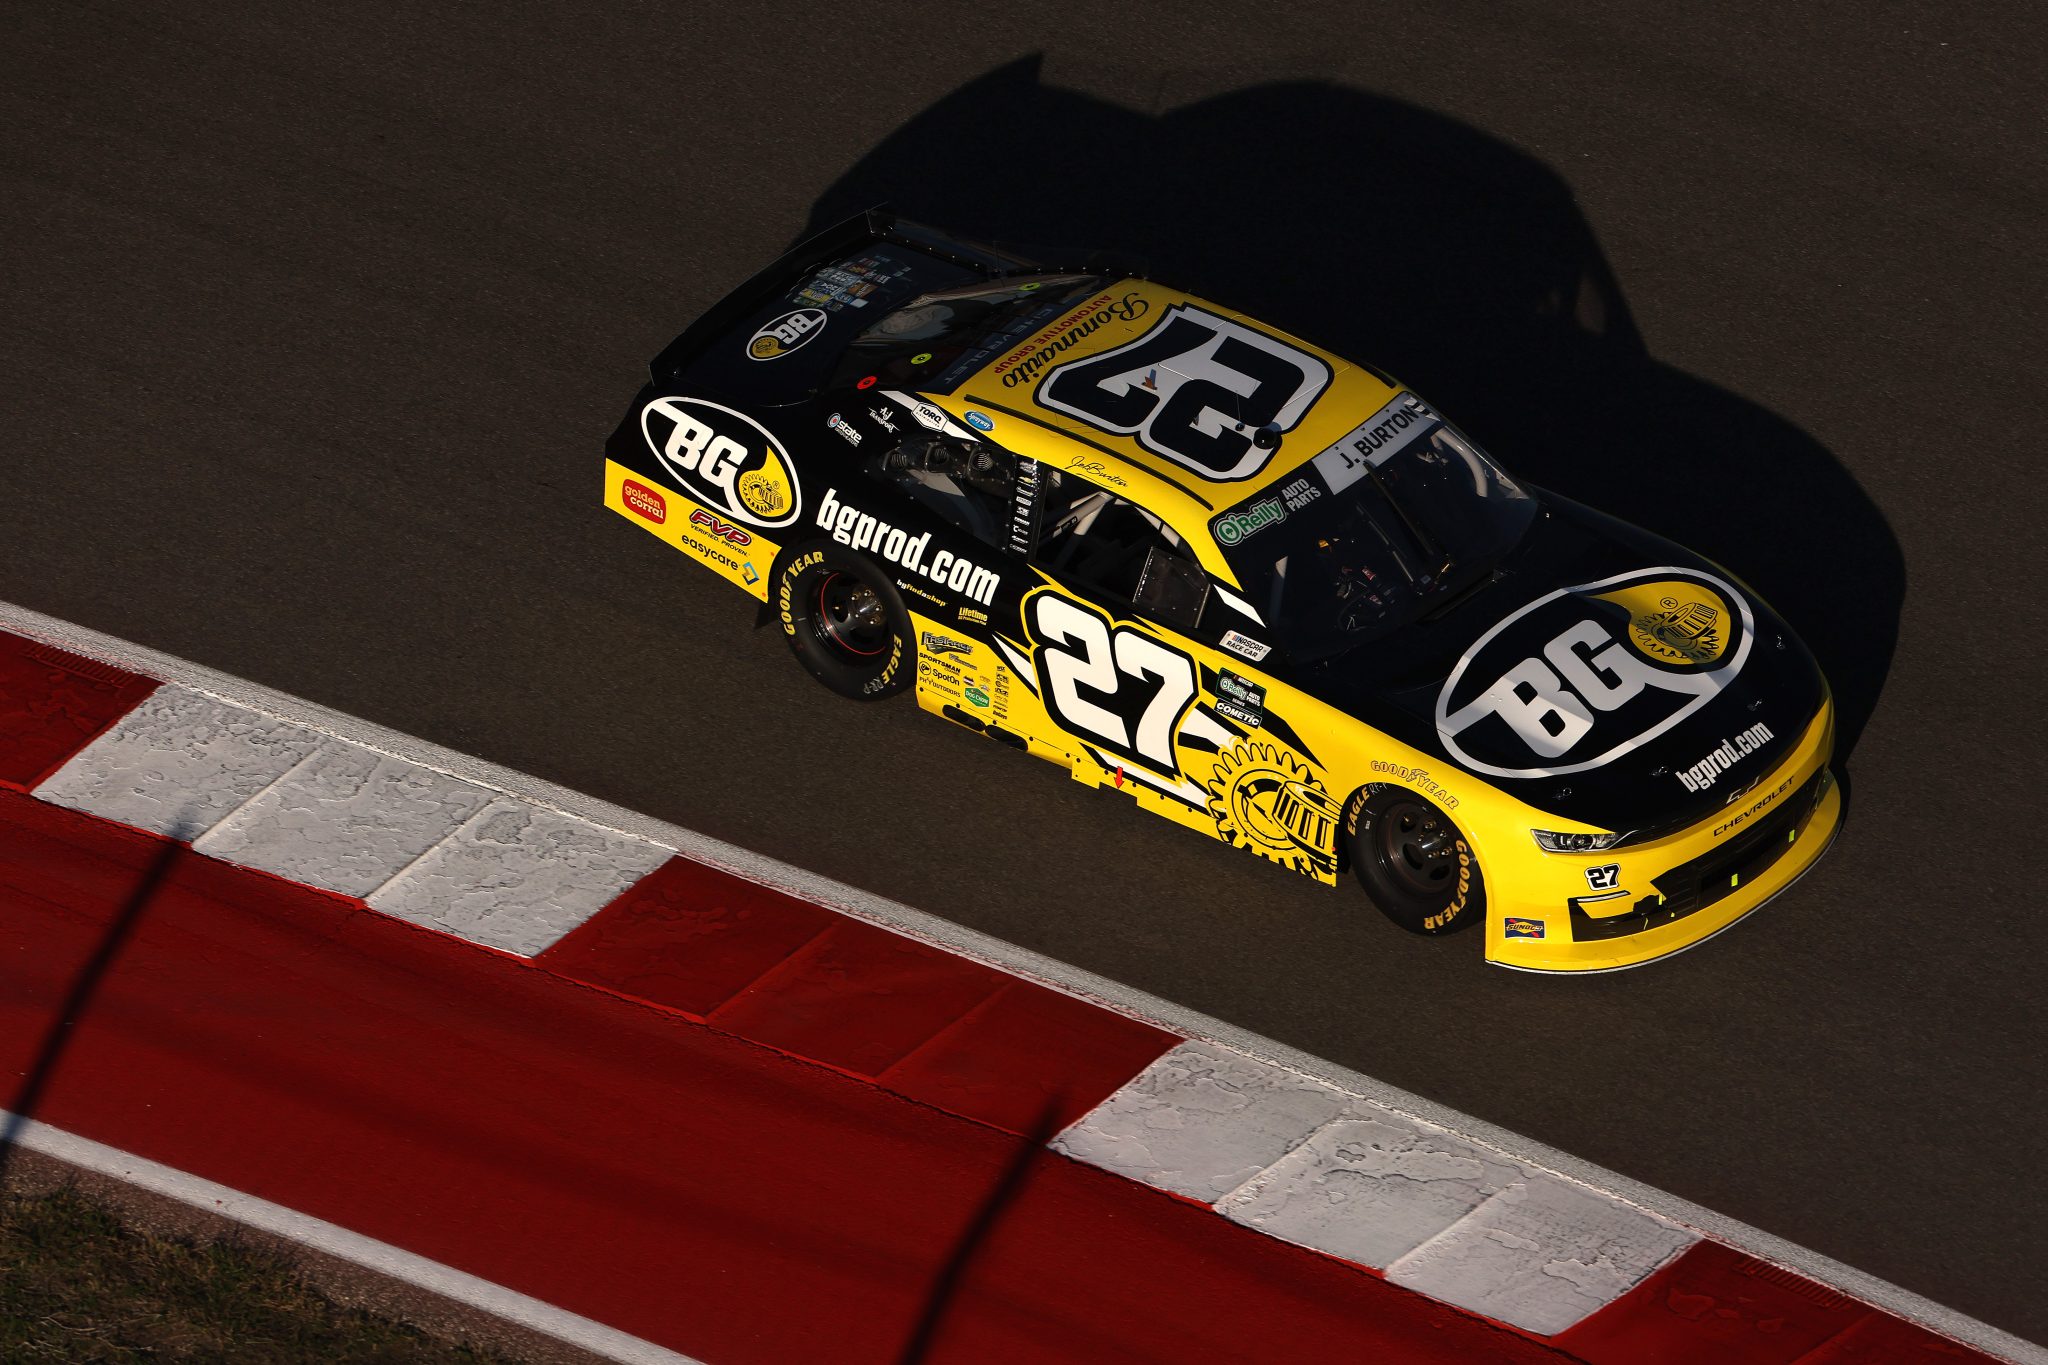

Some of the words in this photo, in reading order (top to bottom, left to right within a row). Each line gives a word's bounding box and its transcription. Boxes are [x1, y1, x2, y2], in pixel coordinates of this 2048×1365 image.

[779, 312, 821, 345] BG
[1034, 294, 1112, 346] AUTOMOTIVE
[1002, 292, 1149, 388] Bommarito
[994, 344, 1037, 374] GROUP
[869, 408, 900, 434] TRANSPORT
[919, 406, 942, 423] TORQ
[837, 419, 862, 444] state
[1339, 452, 1360, 470] J.
[1353, 404, 1421, 458] BURTON
[656, 408, 748, 489] BG
[624, 484, 661, 511] golden
[1281, 478, 1311, 501] AUTO
[1286, 487, 1322, 513] PARTS
[629, 496, 664, 519] corral
[1216, 499, 1283, 544] O'Reilly
[689, 509, 752, 547] FVP
[690, 523, 720, 543] VERIFIED.
[721, 539, 750, 557] PROVEN.
[681, 534, 739, 571] easycare
[816, 488, 1001, 607] bgprod.com
[779, 551, 824, 636] GOODYEAR
[897, 579, 946, 607] bgfindashop
[959, 606, 988, 622] Lifetime
[881, 634, 902, 684] EAGLE
[1226, 640, 1243, 652] RACE
[1243, 647, 1259, 658] CAR
[1236, 636, 1264, 652] NASCAR
[919, 652, 961, 673] SPORTSMAN
[933, 668, 960, 686] SpotOn
[965, 690, 976, 699] DOG
[1036, 595, 1195, 769] 27
[1248, 692, 1261, 701] AUTO
[1486, 619, 1647, 758] BG
[1216, 702, 1260, 726] COMETIC
[1246, 696, 1261, 707] PARTS
[1675, 721, 1775, 793] bgprod.com
[1370, 760, 1460, 811] GOODYEAR
[1347, 787, 1370, 836] EAGLE
[1713, 775, 1795, 837] CHEVROLET
[1423, 839, 1471, 930] GOODYEAR
[1585, 864, 1619, 890] 27
[1505, 923, 1543, 931] SUNOCO
